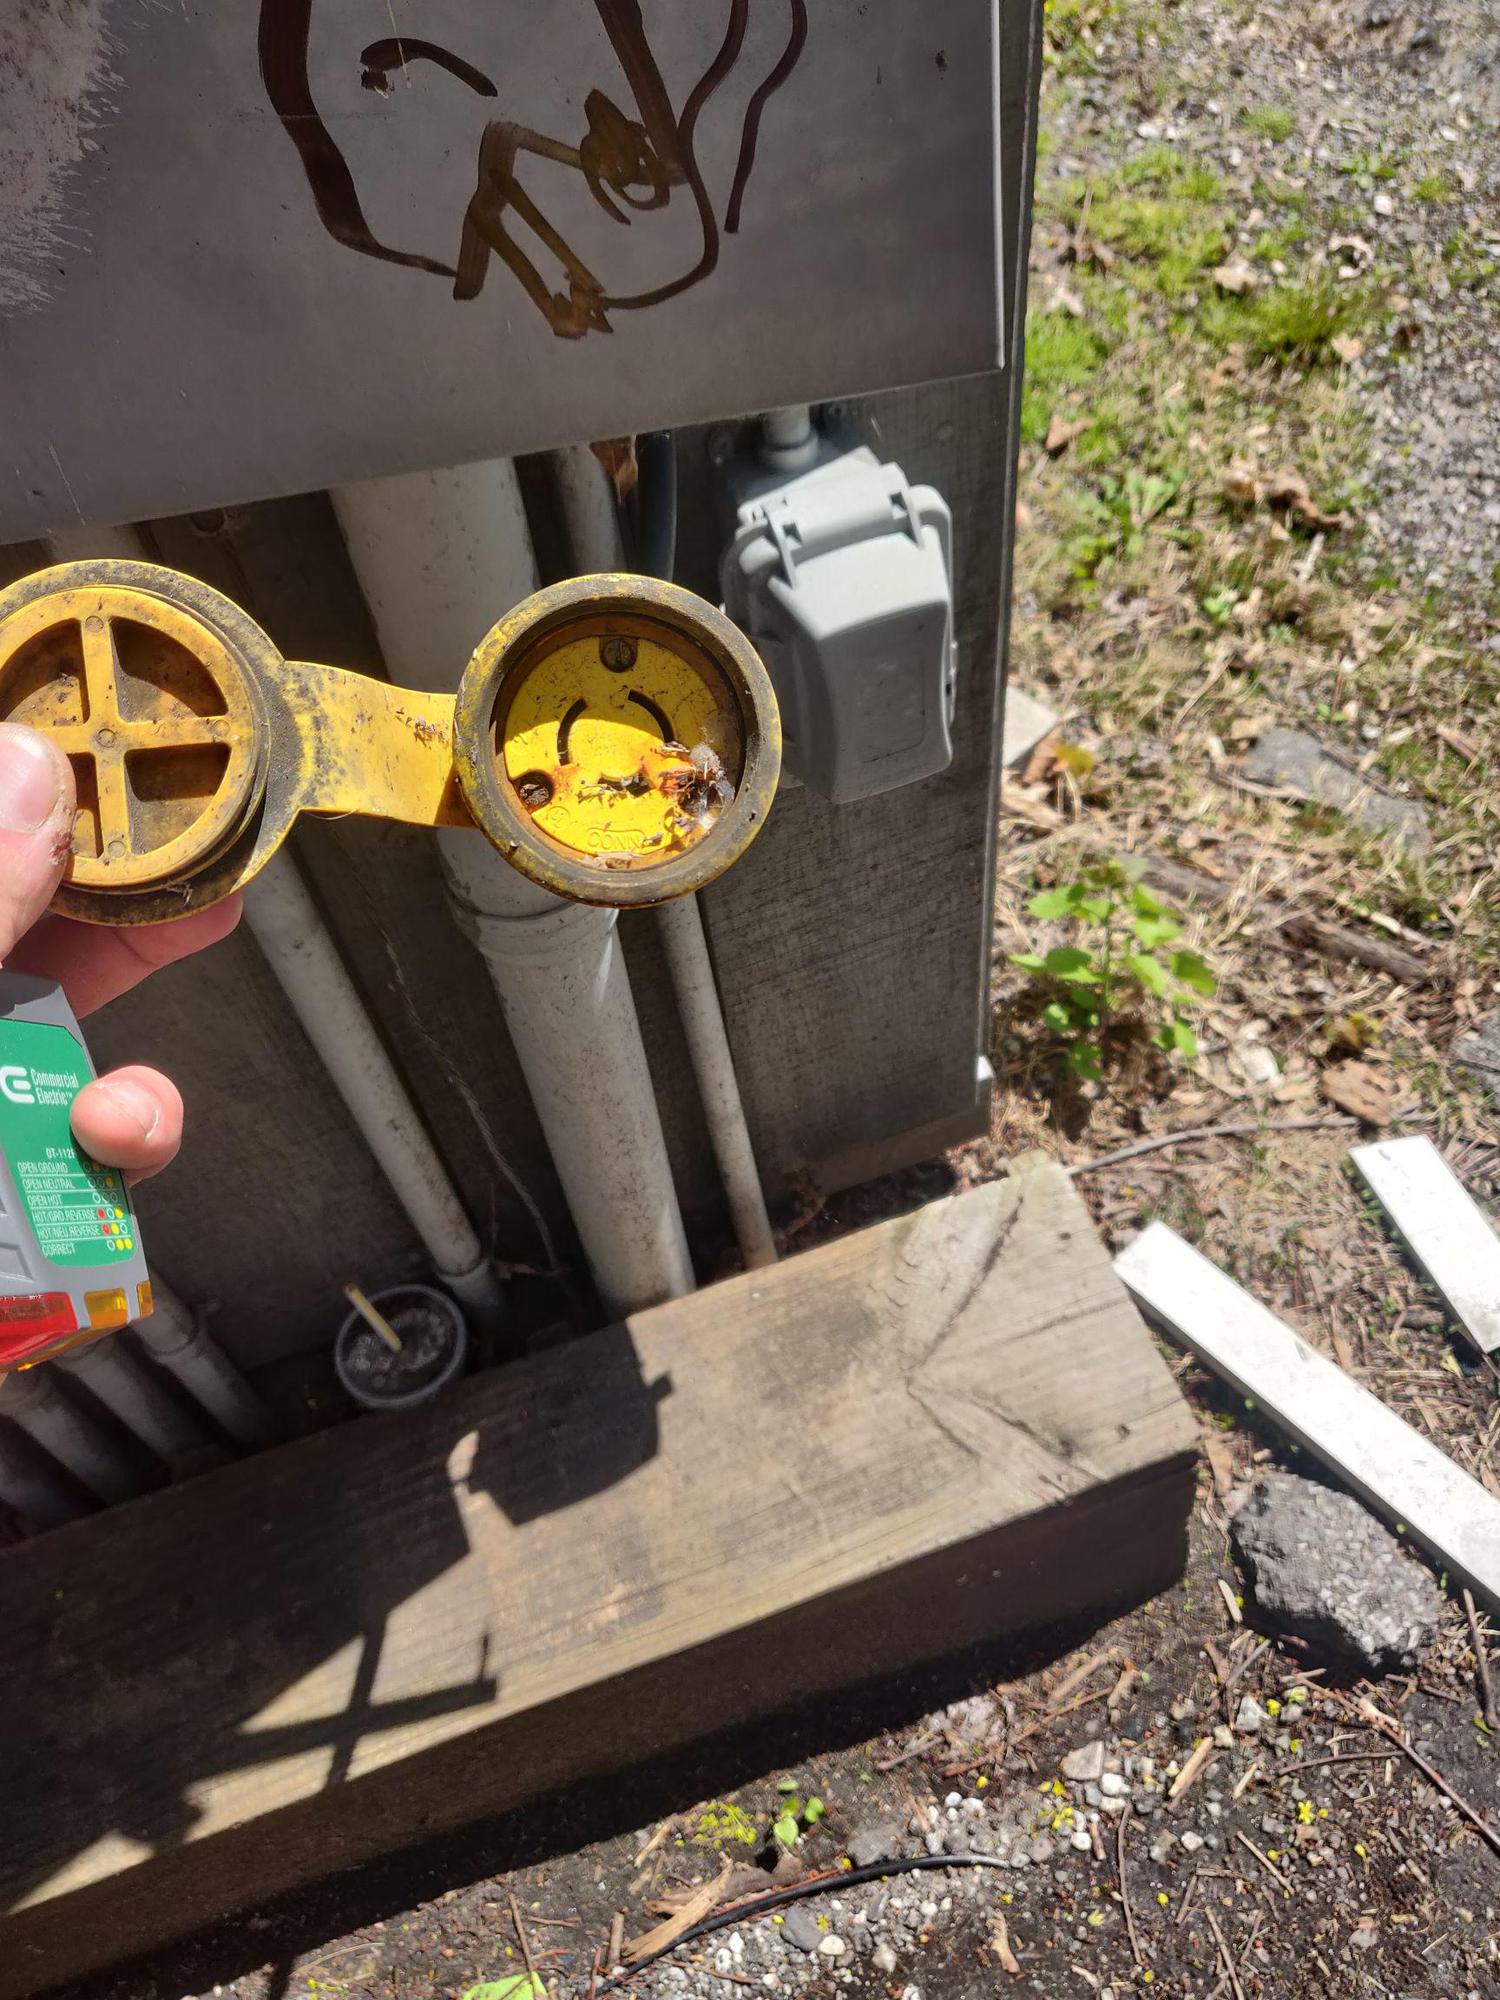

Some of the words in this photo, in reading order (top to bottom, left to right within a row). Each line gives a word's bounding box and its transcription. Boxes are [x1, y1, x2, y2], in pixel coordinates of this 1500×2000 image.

[30, 1067, 79, 1088] Commercial
[17, 1161, 38, 1174] OPEN
[38, 1161, 69, 1173] GROUND
[22, 1178, 43, 1191] OPEN
[42, 1177, 76, 1189] NEUTRAL
[27, 1194, 48, 1208] OPEN
[47, 1194, 63, 1206] HOT
[41, 1242, 76, 1257] CORRECT
